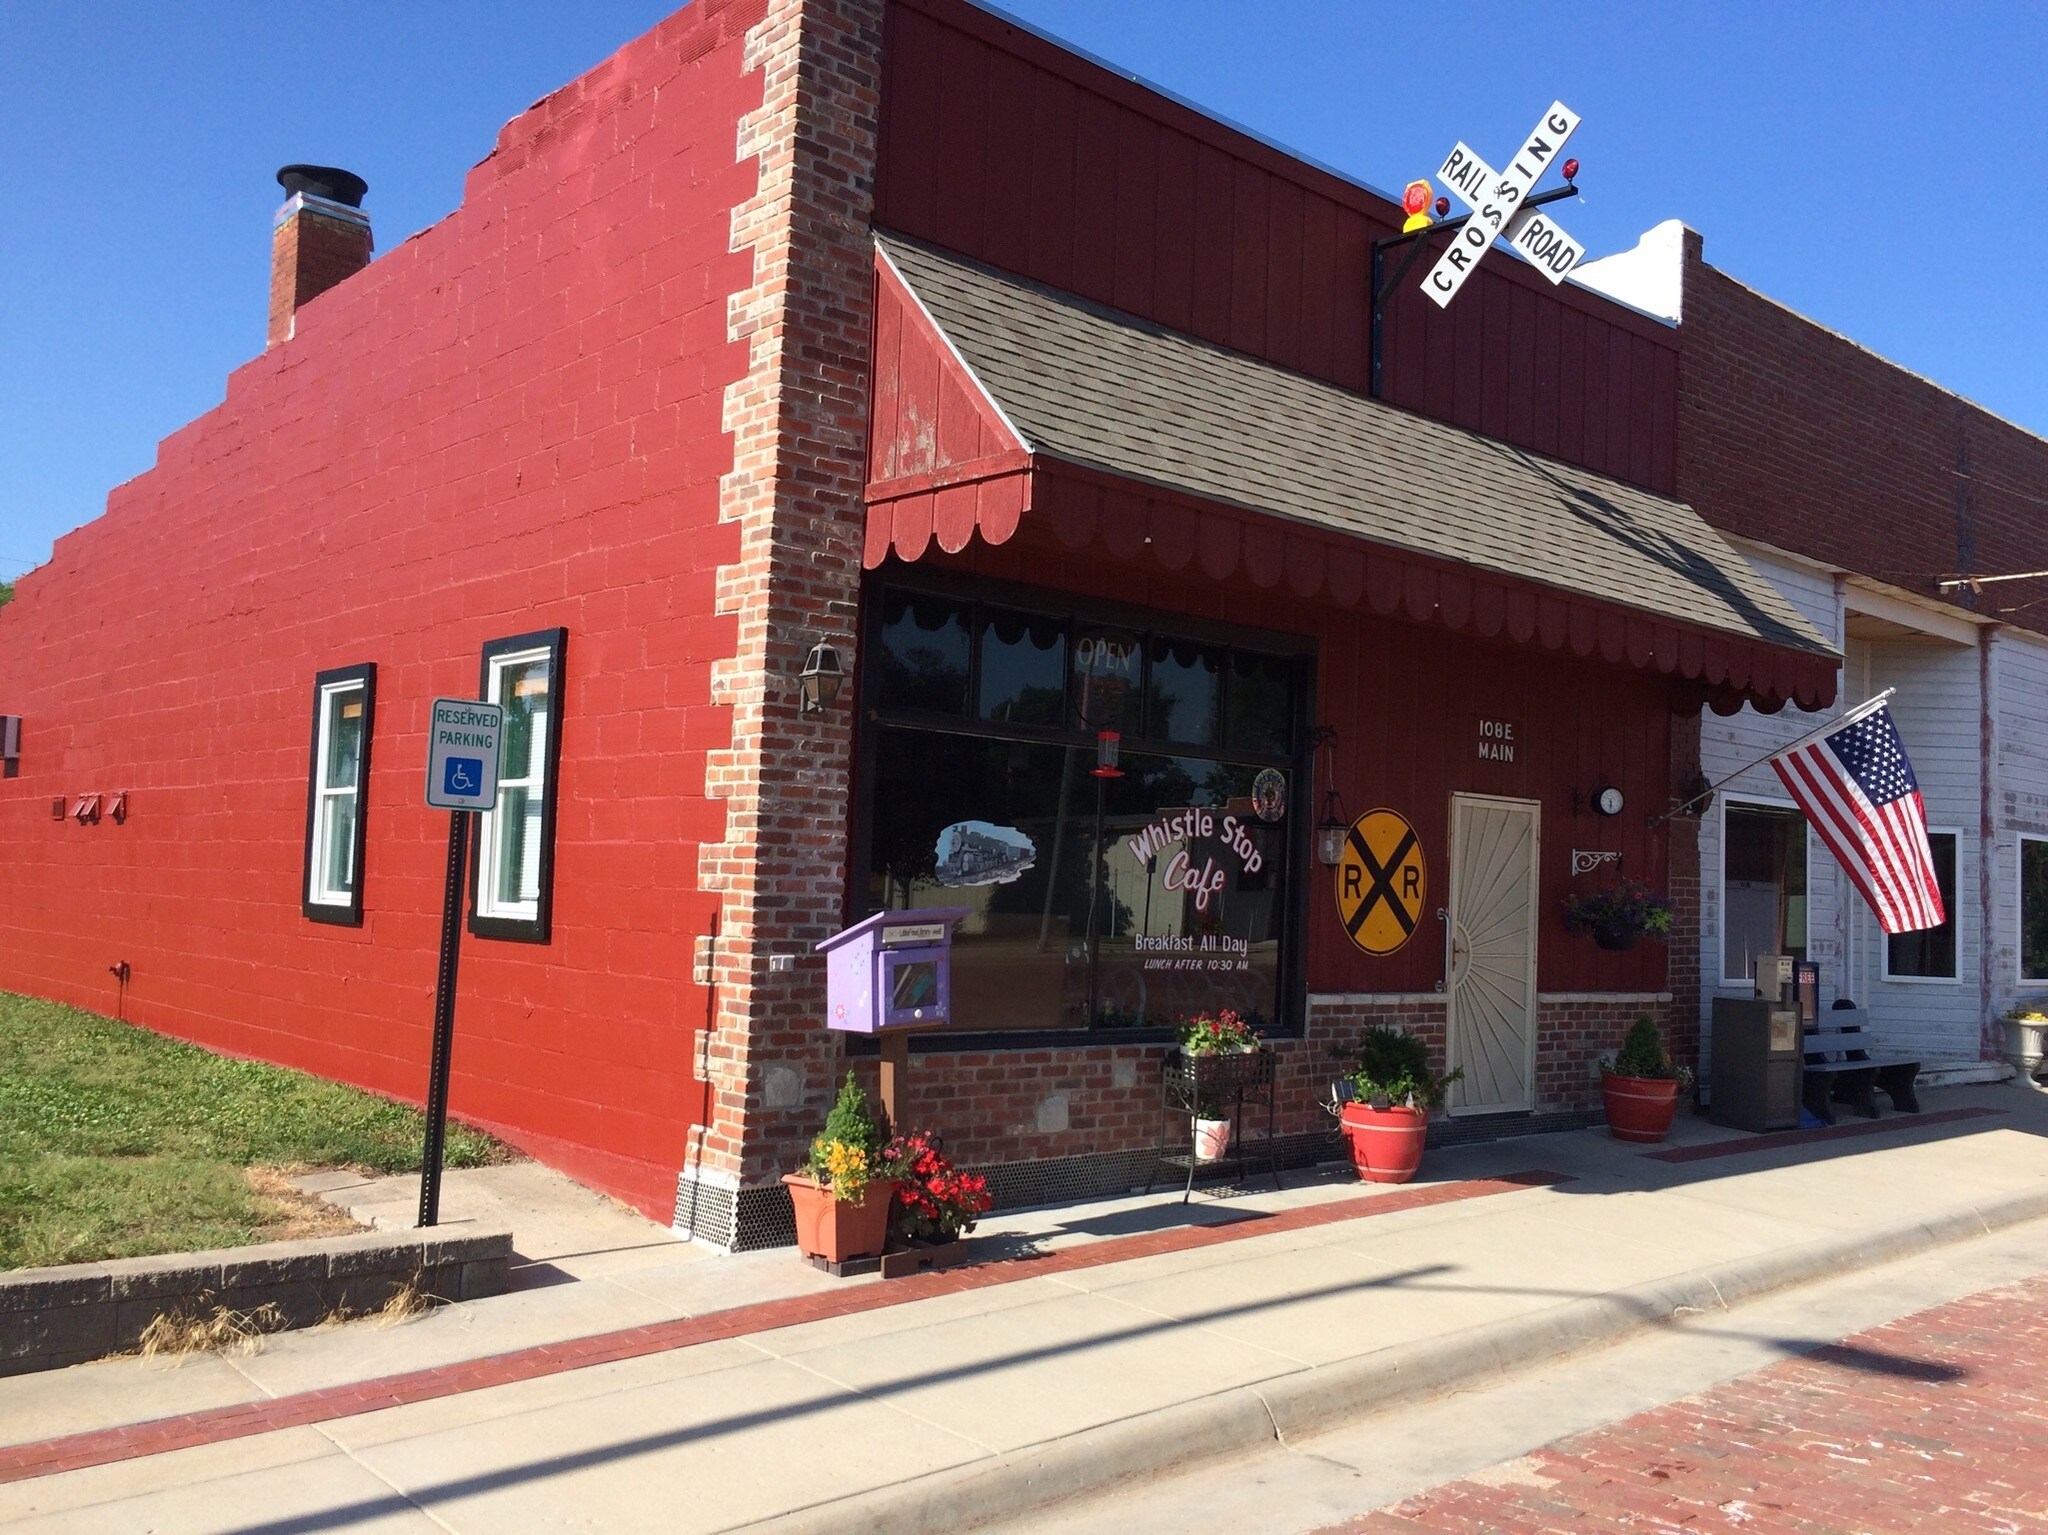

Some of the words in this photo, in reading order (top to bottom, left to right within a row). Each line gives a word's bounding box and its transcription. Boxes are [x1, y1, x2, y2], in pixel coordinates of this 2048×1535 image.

[1433, 114, 1568, 292] CROSSING
[1442, 149, 1487, 202] RAIL
[1519, 219, 1575, 274] ROAD
[1078, 637, 1132, 671] OPEN
[437, 709, 498, 727] RESERVED
[440, 731, 492, 748] PARKING
[1478, 741, 1514, 762] MAIN
[1128, 808, 1214, 867] Whistle
[1219, 815, 1263, 874] Stop
[1163, 850, 1225, 911] Cafe
[1135, 933, 1194, 951] Breakfast
[1200, 934, 1217, 952] All
[1222, 935, 1248, 958] Day
[1144, 958, 1172, 969] LUNCH
[1174, 959, 1203, 970] AFTER
[1207, 960, 1233, 971] 10:30
[1236, 961, 1249, 971] AM
